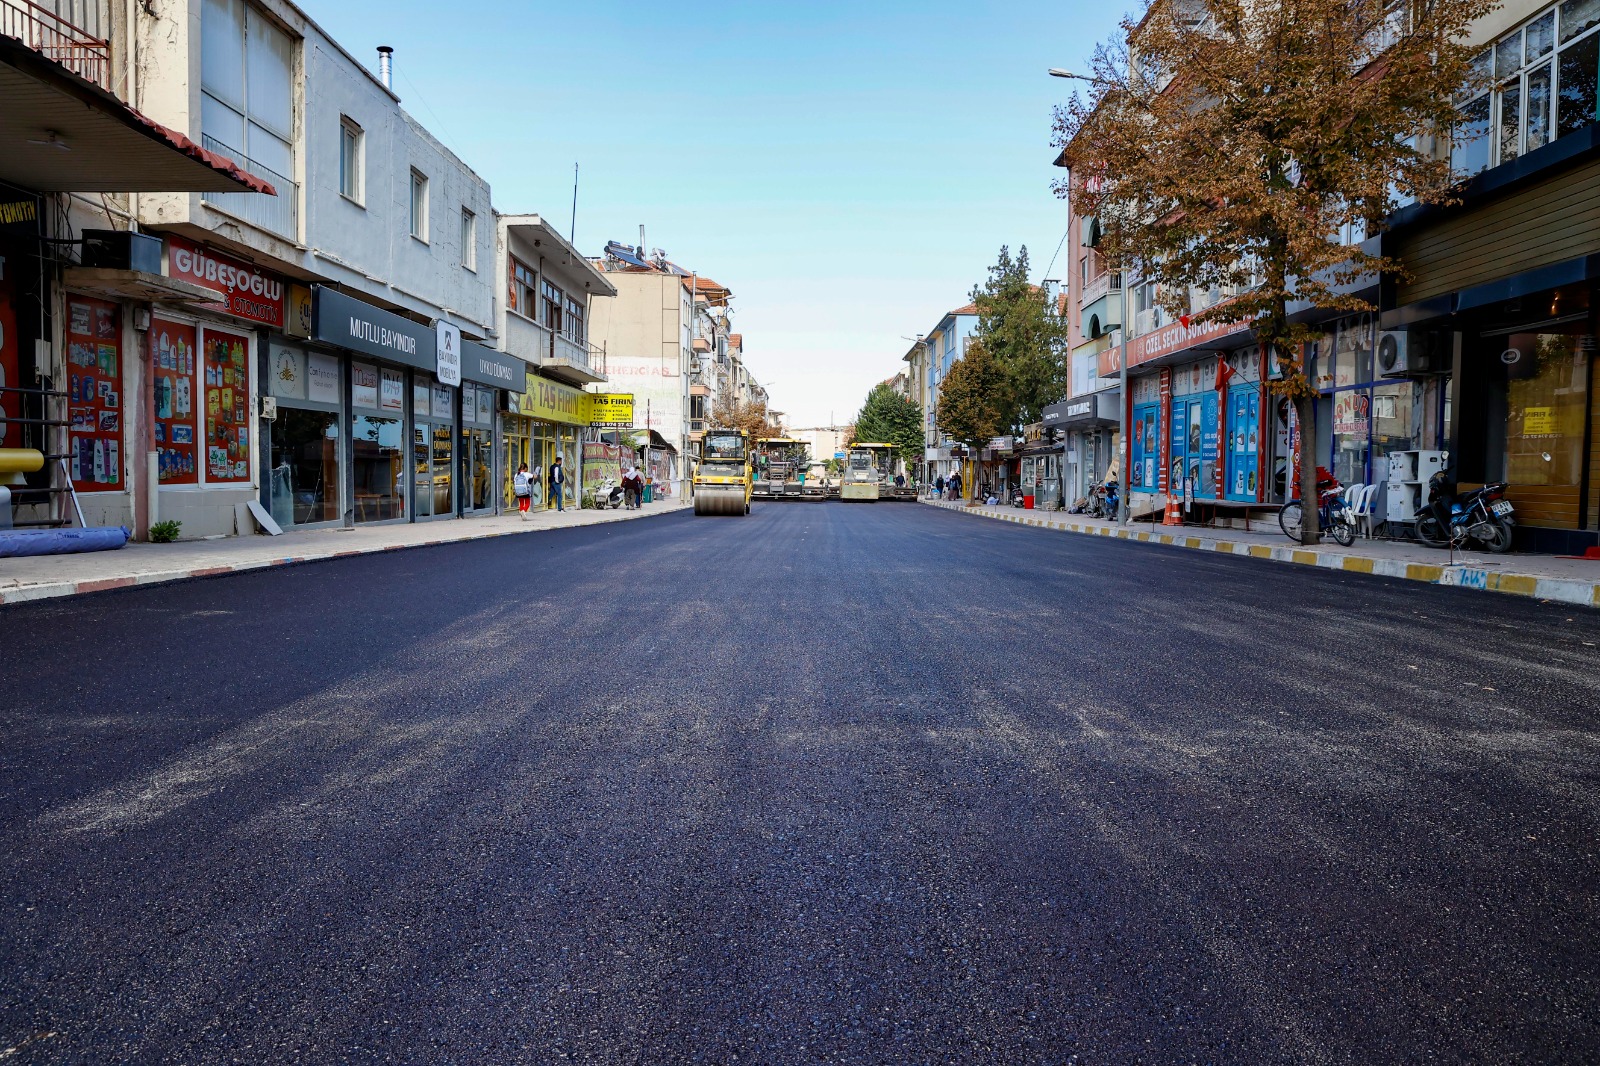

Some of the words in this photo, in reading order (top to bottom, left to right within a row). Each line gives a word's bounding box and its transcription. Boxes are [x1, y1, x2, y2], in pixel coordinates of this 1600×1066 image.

[175, 248, 280, 301] GÜBEŞOĞLU
[234, 297, 278, 321] OTOMOTİV
[350, 316, 380, 343] MUTLU
[381, 328, 416, 355] BAYINDIR
[1145, 335, 1161, 354] ÖZEL
[1162, 323, 1187, 351] SEÇKİN
[438, 350, 458, 366] BAYINDIR
[480, 359, 494, 376] UYKU
[538, 381, 556, 414] TAŞ
[557, 388, 579, 415] FIRIN
[1336, 393, 1369, 419] ONUR
